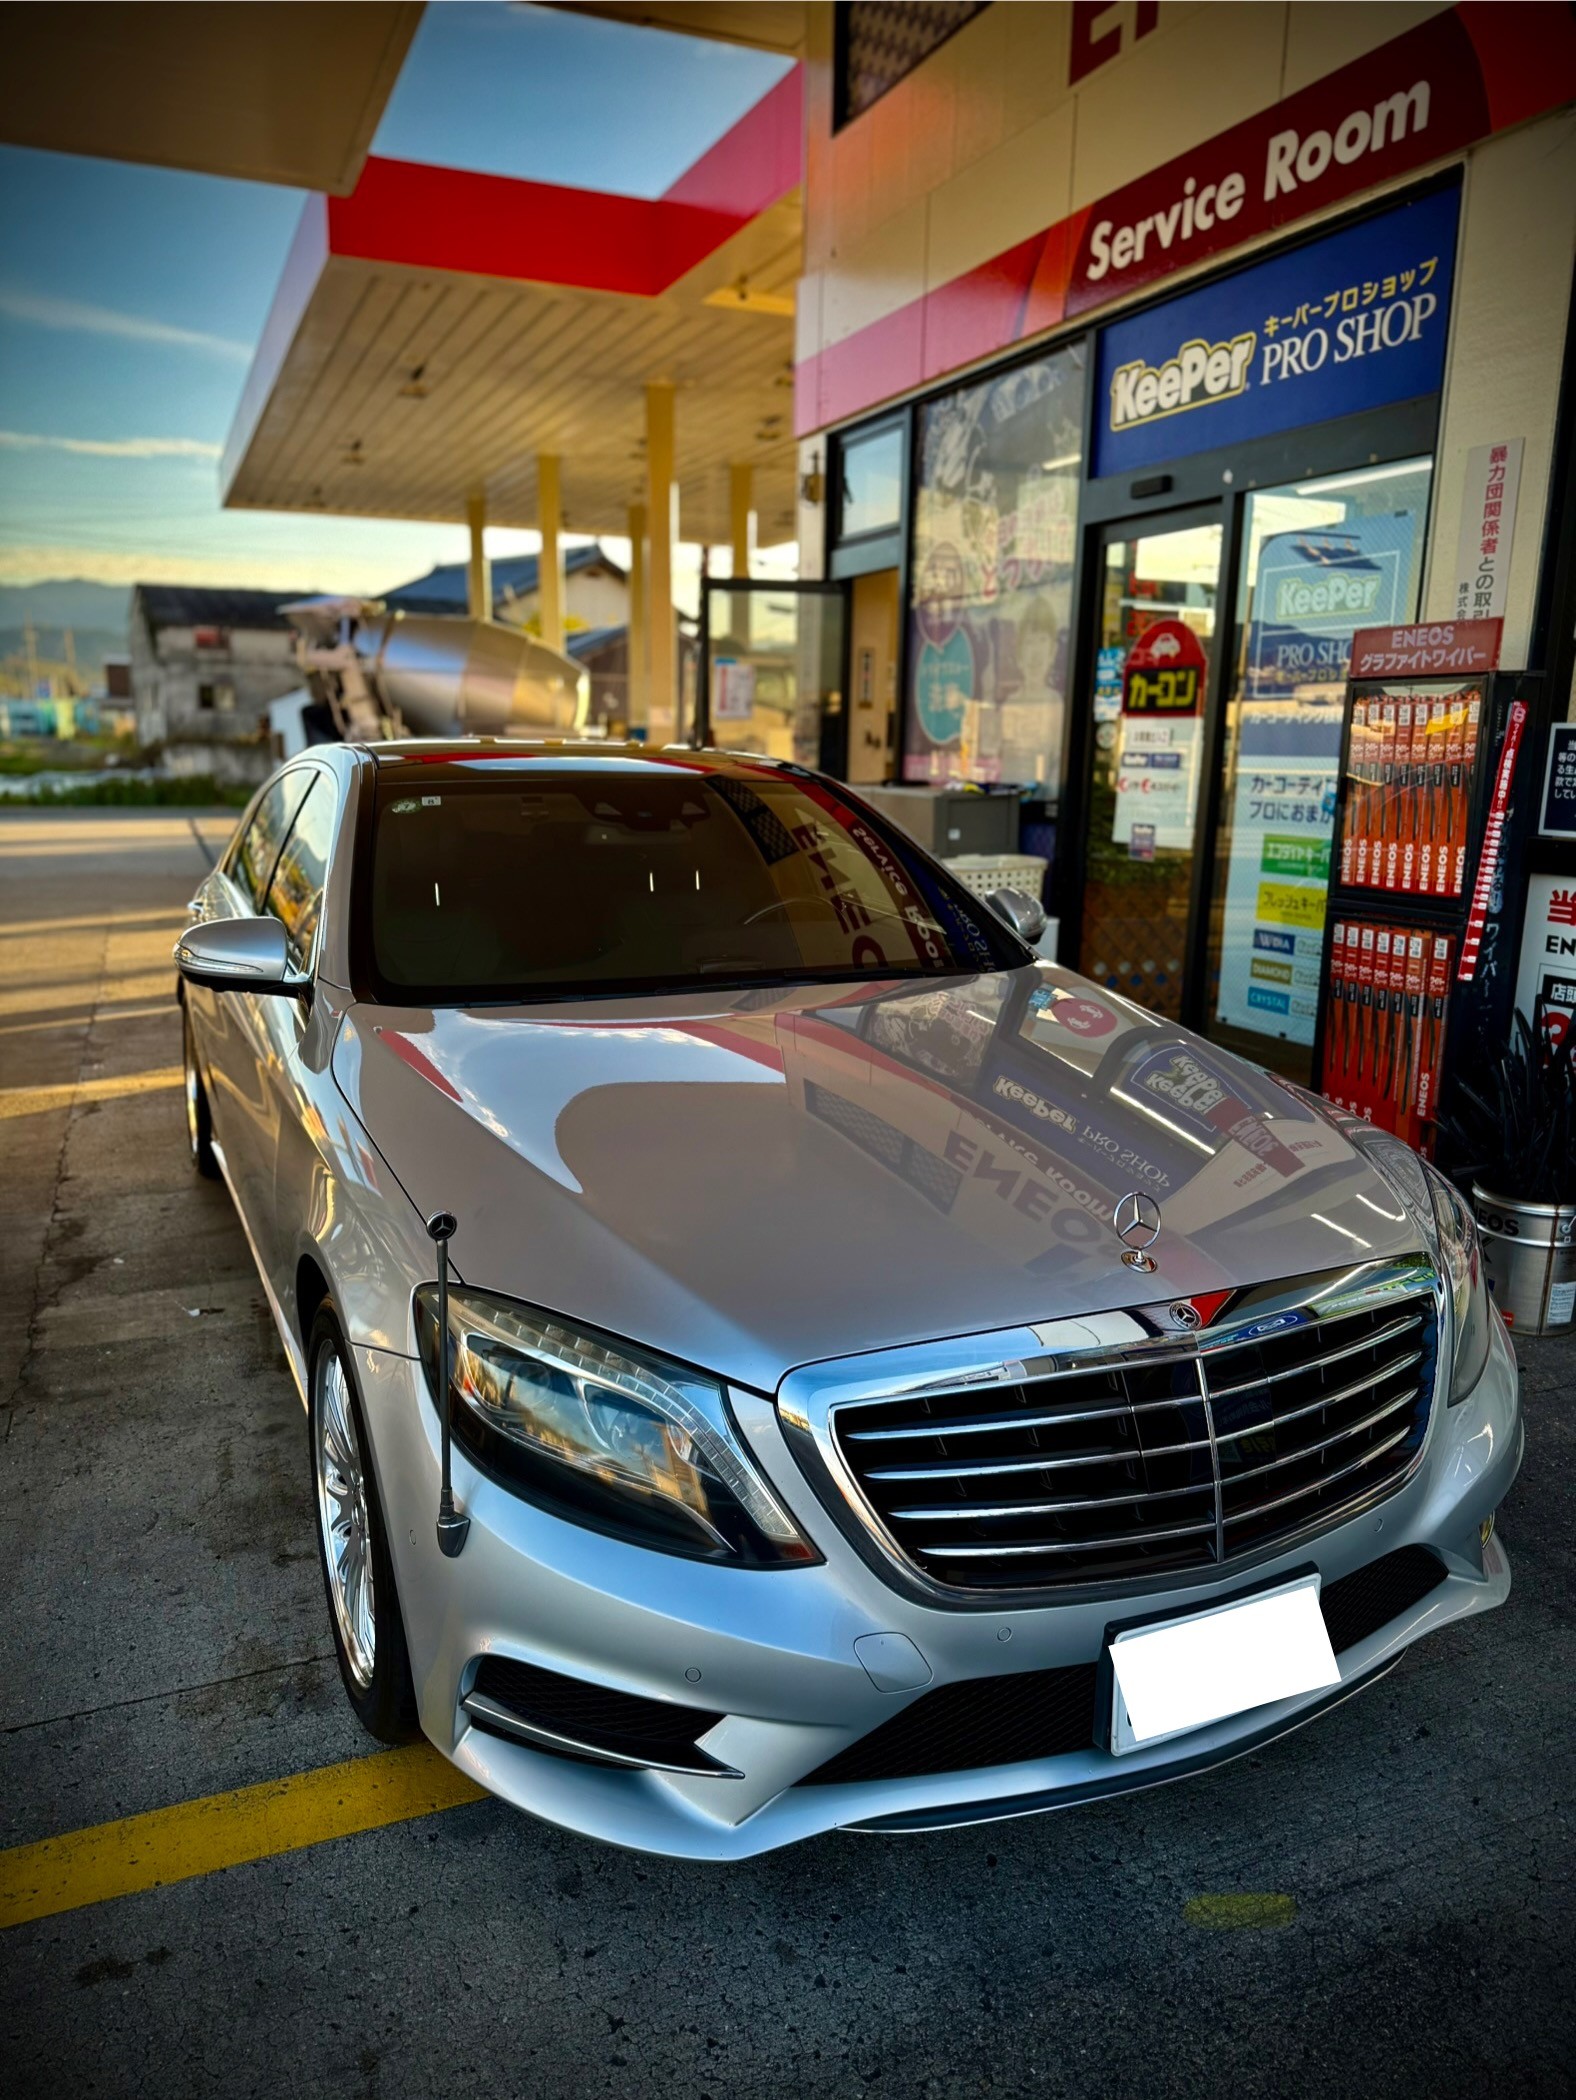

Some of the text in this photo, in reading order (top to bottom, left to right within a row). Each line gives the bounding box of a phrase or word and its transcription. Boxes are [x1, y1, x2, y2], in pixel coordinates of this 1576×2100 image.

[1086, 80, 1431, 281] Service Room
[1263, 256, 1439, 339] キーパープロショップ
[1259, 292, 1438, 387] PRO SHOP
[1111, 333, 1257, 431] KeePer
[1276, 573, 1382, 622] KeePer
[1276, 642, 1315, 669] PRO
[1360, 645, 1487, 673] グラファイトワイパー
[1391, 625, 1455, 649] ENEOS
[1370, 840, 1382, 885] ENEOS
[1386, 842, 1398, 888] ENEOS
[1402, 843, 1414, 889] ENEOS
[1419, 844, 1431, 891] ENEOS
[1435, 845, 1449, 893] ENEOS
[1453, 845, 1466, 894] ENEOS
[1416, 1072, 1431, 1117] ENEOS
